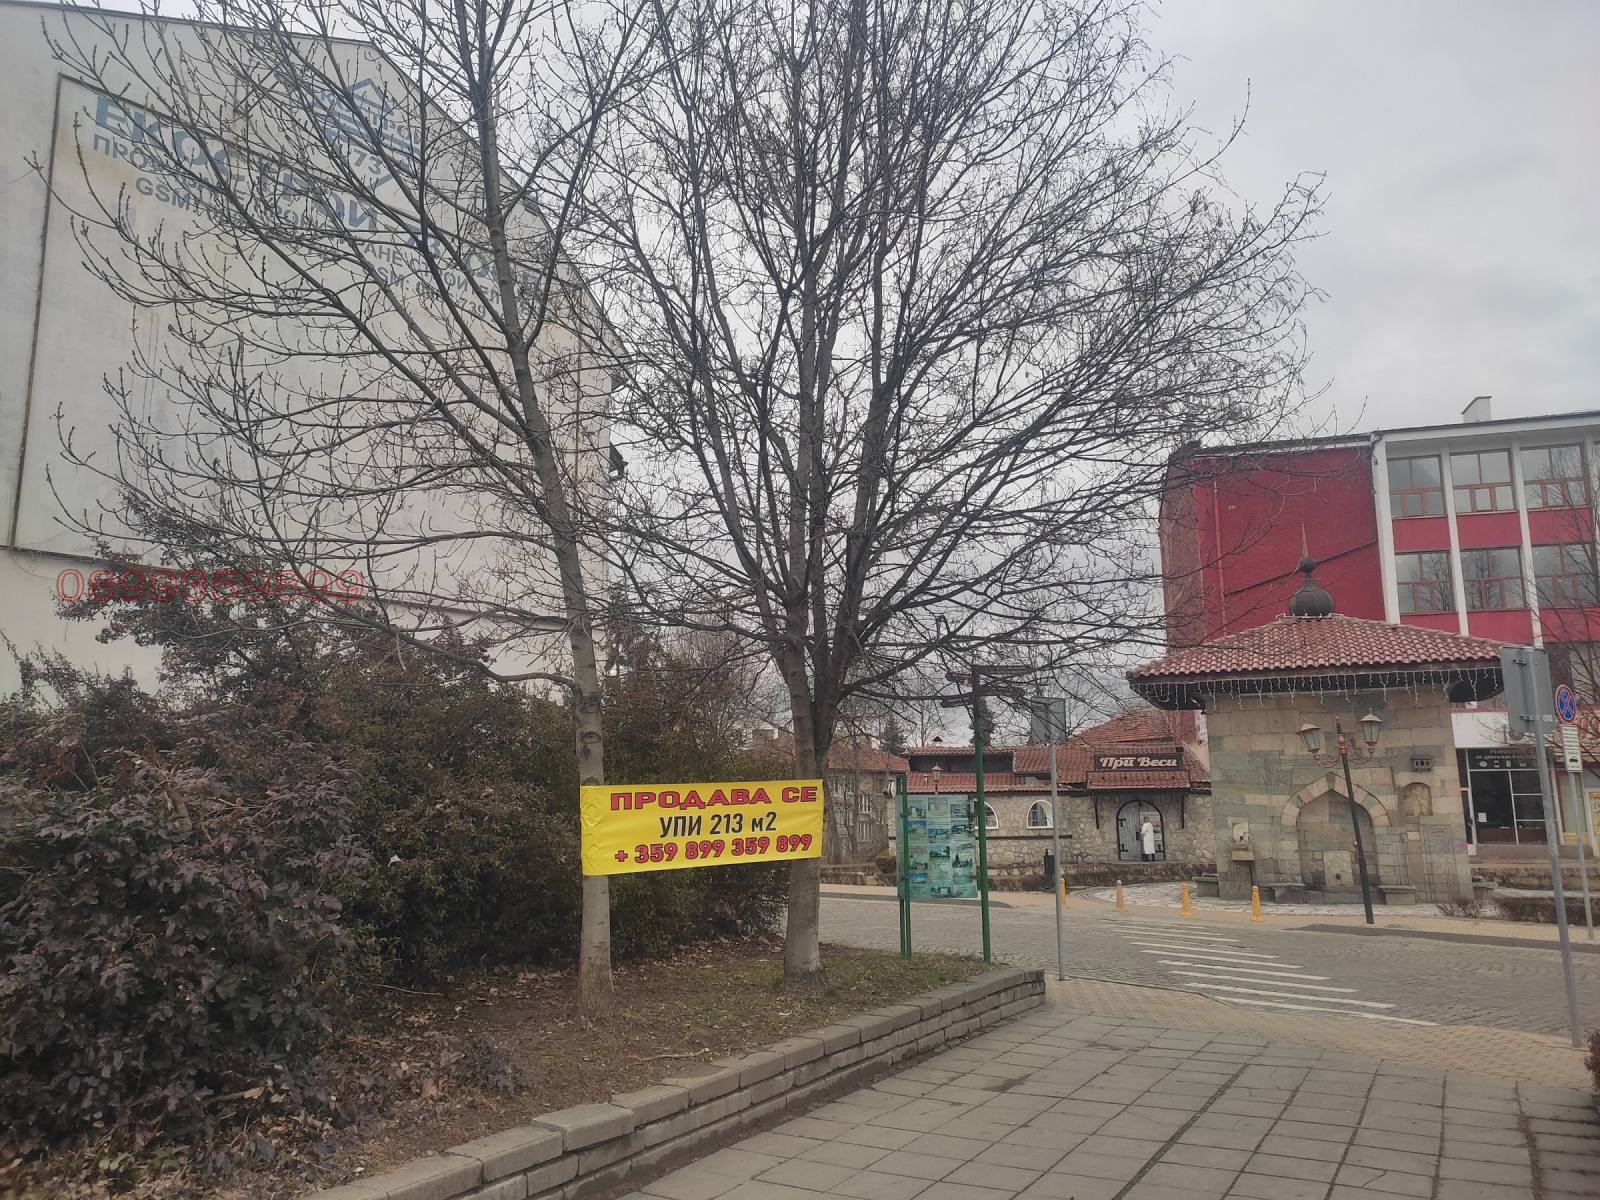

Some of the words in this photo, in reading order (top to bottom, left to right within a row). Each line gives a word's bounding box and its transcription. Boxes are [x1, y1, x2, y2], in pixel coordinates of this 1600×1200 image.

[1137, 756, 1178, 767] Веси
[611, 788, 772, 810] ПРОДАВА
[781, 787, 817, 803] СЕ
[659, 814, 702, 838] УПИ
[709, 812, 744, 835] 213
[751, 811, 777, 833] м2
[635, 843, 678, 864] 359
[685, 839, 725, 860] 899
[731, 837, 770, 856] 359
[776, 834, 813, 853] 899
